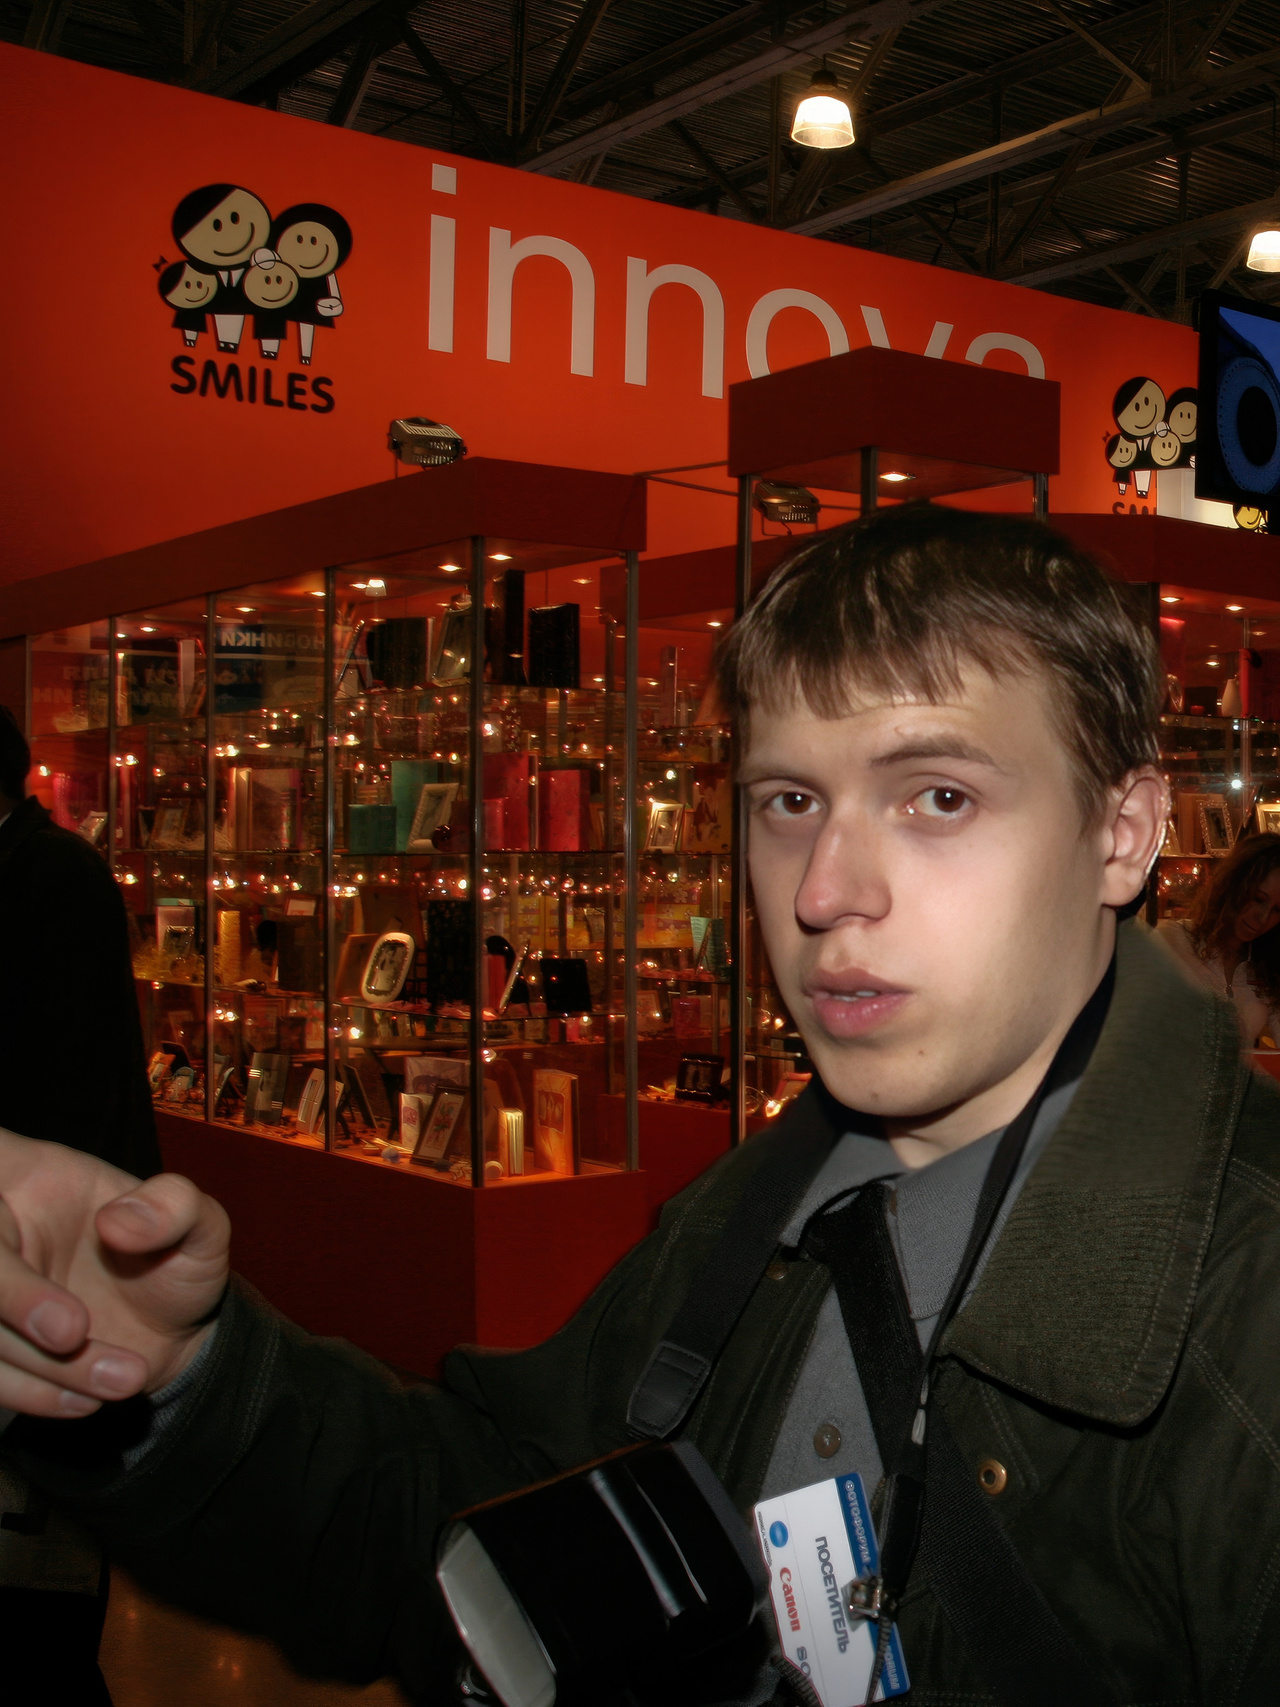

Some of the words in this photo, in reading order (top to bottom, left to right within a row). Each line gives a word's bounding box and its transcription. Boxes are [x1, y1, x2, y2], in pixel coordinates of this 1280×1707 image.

[170, 355, 335, 414] SMILES
[779, 1566, 801, 1632] Canon
[814, 1535, 851, 1654] ПОСЕТИТЕЛЬ
